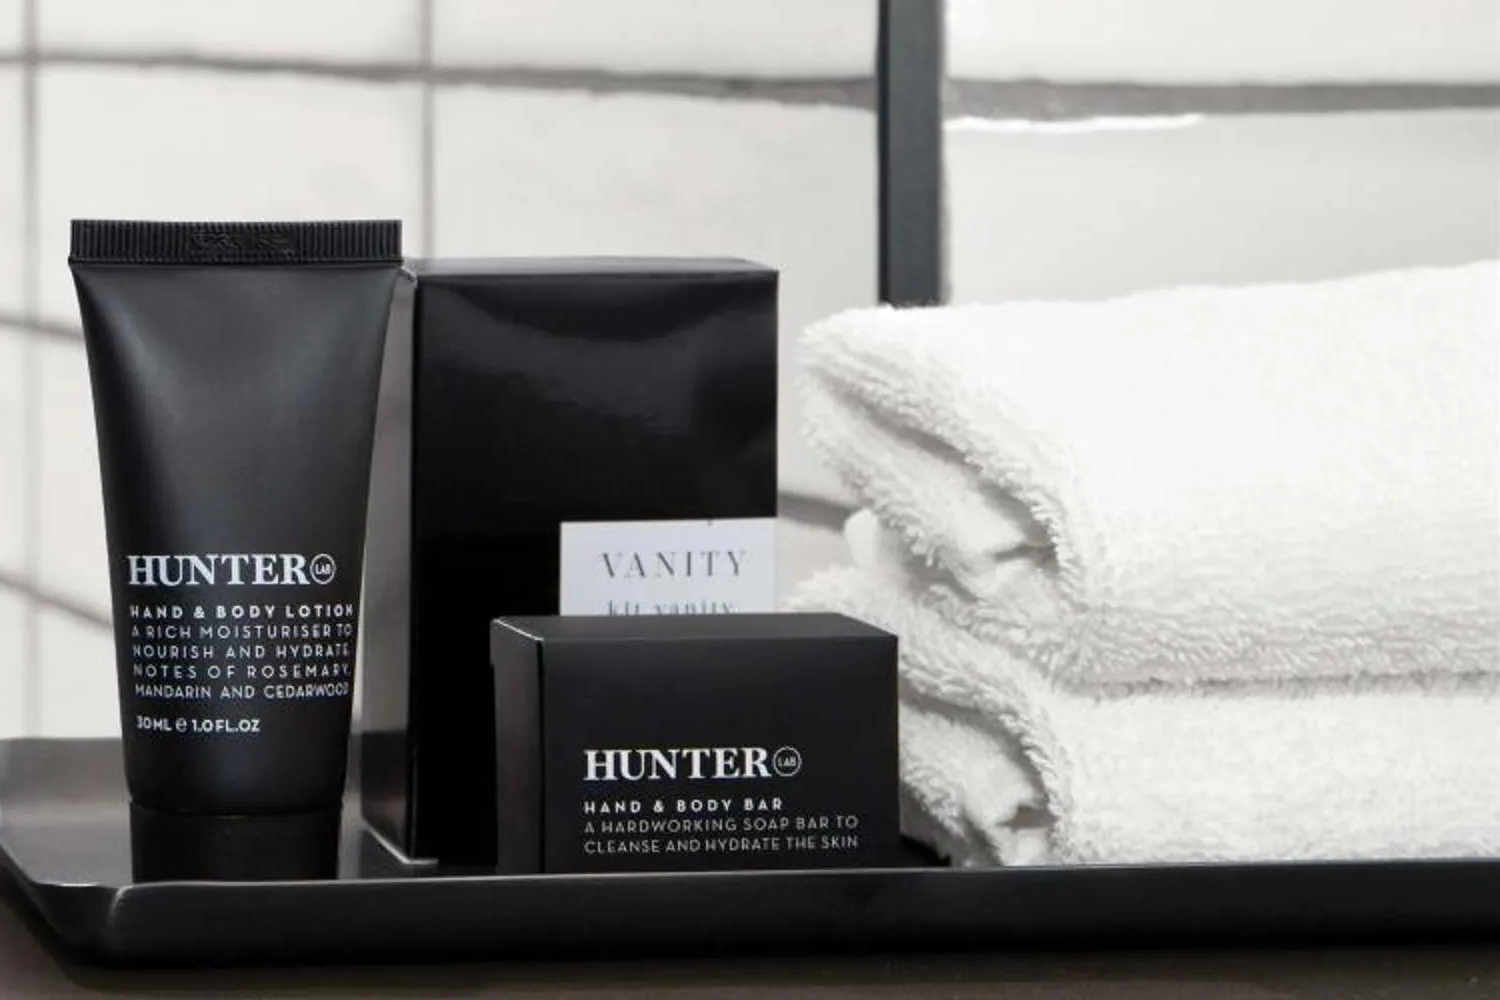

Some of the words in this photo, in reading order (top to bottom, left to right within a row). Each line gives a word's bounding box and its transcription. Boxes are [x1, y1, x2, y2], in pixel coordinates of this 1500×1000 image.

[127, 554, 310, 587] HUNTER
[601, 551, 746, 578] VANITY
[129, 604, 184, 619] HAND
[193, 605, 205, 619] &
[216, 605, 276, 619] BODY
[285, 603, 353, 619] LOTION
[131, 626, 140, 638] A
[147, 626, 192, 639] RICH
[200, 624, 331, 639] MOISTURISER
[336, 623, 353, 636] TO
[132, 645, 214, 659] NOURISH
[225, 645, 266, 659] AND
[276, 643, 349, 658] HYDRATE
[133, 665, 197, 679] NOTES
[207, 665, 236, 679] OF
[134, 684, 211, 699] MANDARIN
[220, 685, 256, 699] AND
[583, 747, 772, 781] HUNTER
[584, 800, 642, 814] HAND
[653, 800, 664, 813] &
[677, 799, 732, 813] BODY
[744, 798, 783, 811] BAR
[584, 820, 595, 834] A
[601, 818, 737, 833] HARDWORKING
[743, 817, 789, 831] SOAP
[795, 816, 830, 830] BAR
[836, 815, 859, 829] TO
[584, 840, 660, 855] CLEANSE
[665, 839, 701, 853] AND
[705, 837, 781, 852] HYDRATE
[786, 837, 816, 850] THE
[821, 836, 858, 850] SKIN
